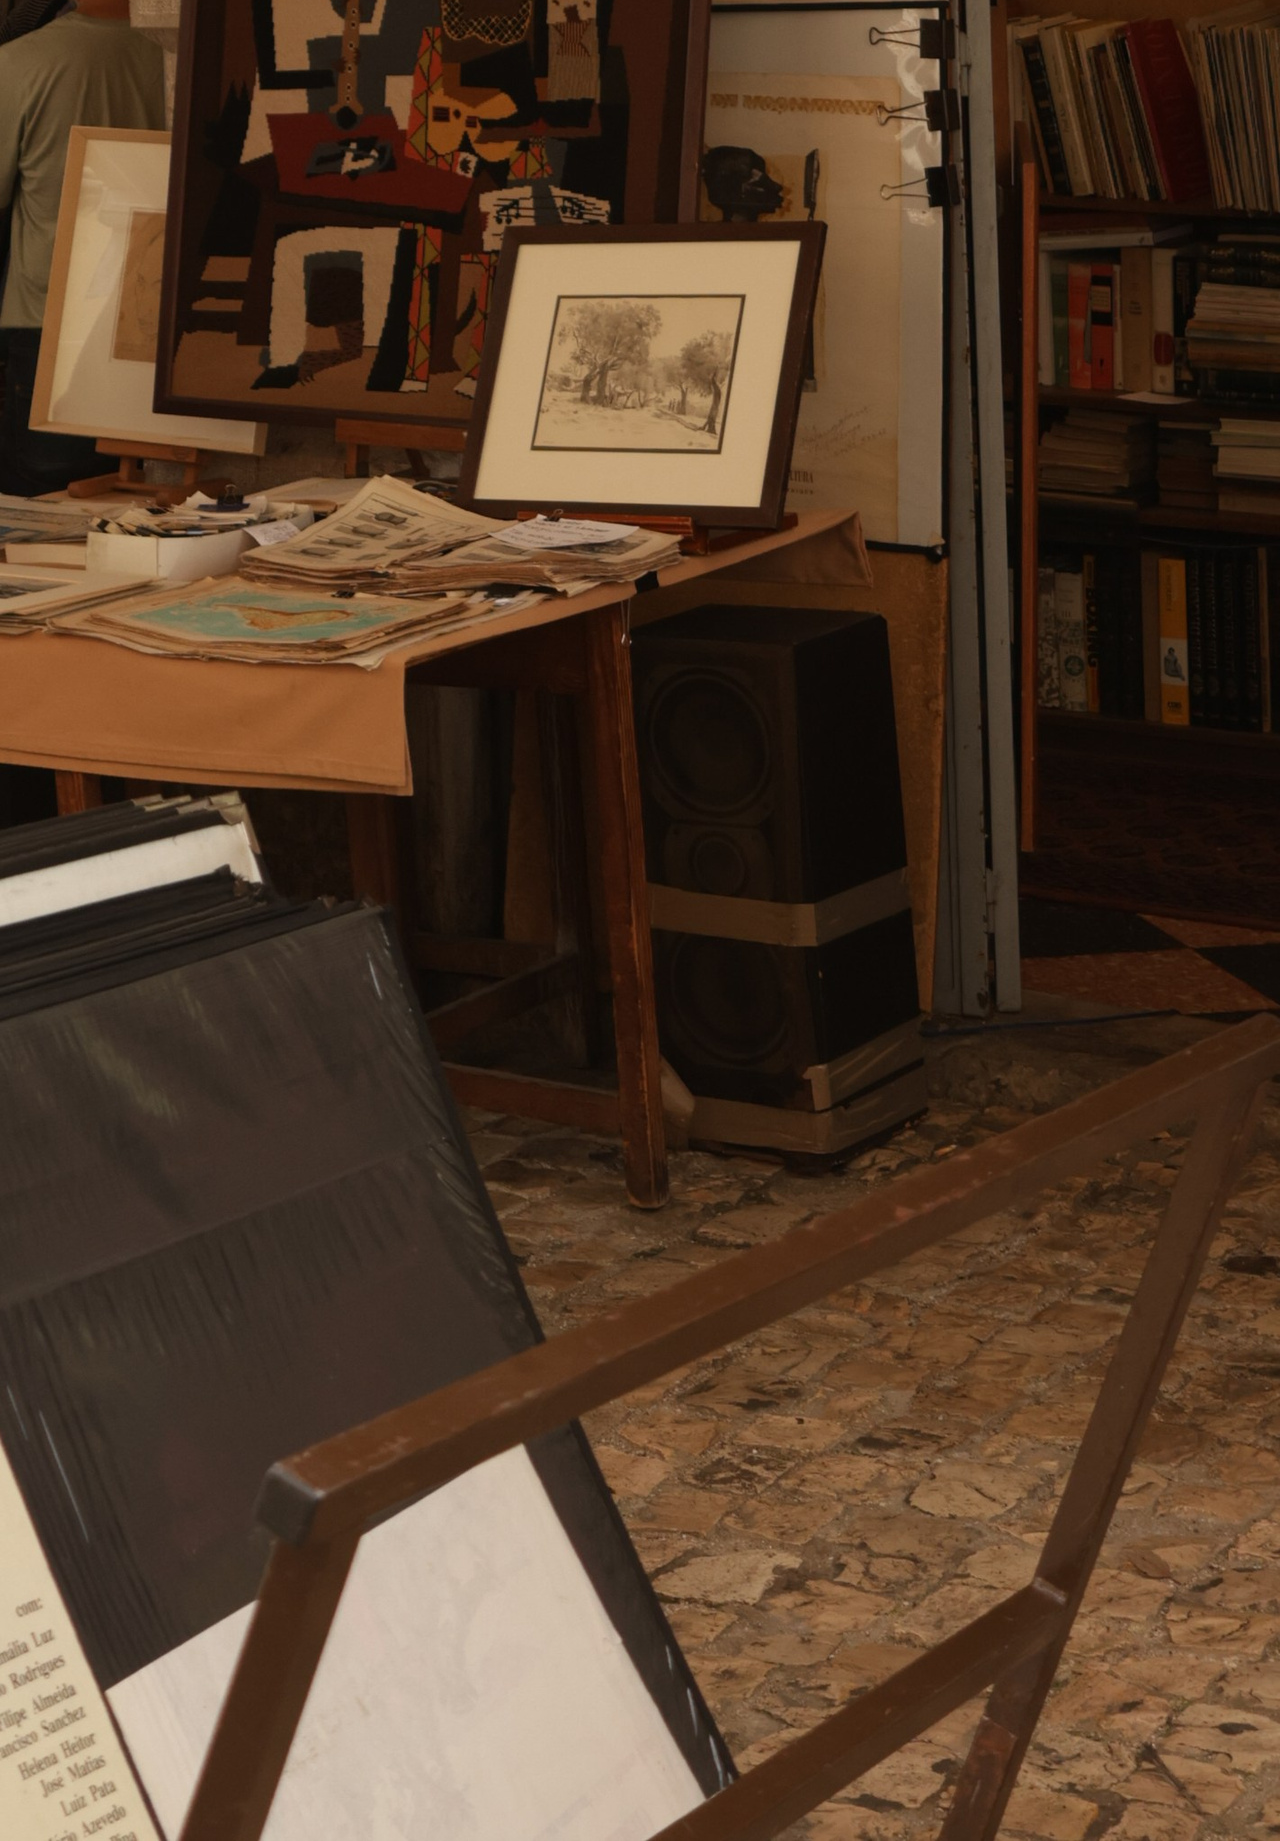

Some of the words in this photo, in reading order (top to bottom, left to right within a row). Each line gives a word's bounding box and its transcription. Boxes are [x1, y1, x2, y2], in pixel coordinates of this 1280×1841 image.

[1085, 587, 1098, 668] BOXING
[14, 1597, 44, 1618] com:
[30, 1628, 55, 1648] Luz
[9, 1654, 66, 1690] Rodrigues
[31, 1682, 77, 1715] Almeida
[39, 1704, 87, 1737] Sanchez
[17, 1751, 59, 1781] Helena
[59, 1731, 97, 1759] Heitor
[38, 1771, 65, 1798] José
[67, 1753, 107, 1782] Matias
[59, 1793, 88, 1818] Luiz
[88, 1777, 117, 1803] Pata
[80, 1803, 127, 1837] Azevedo
